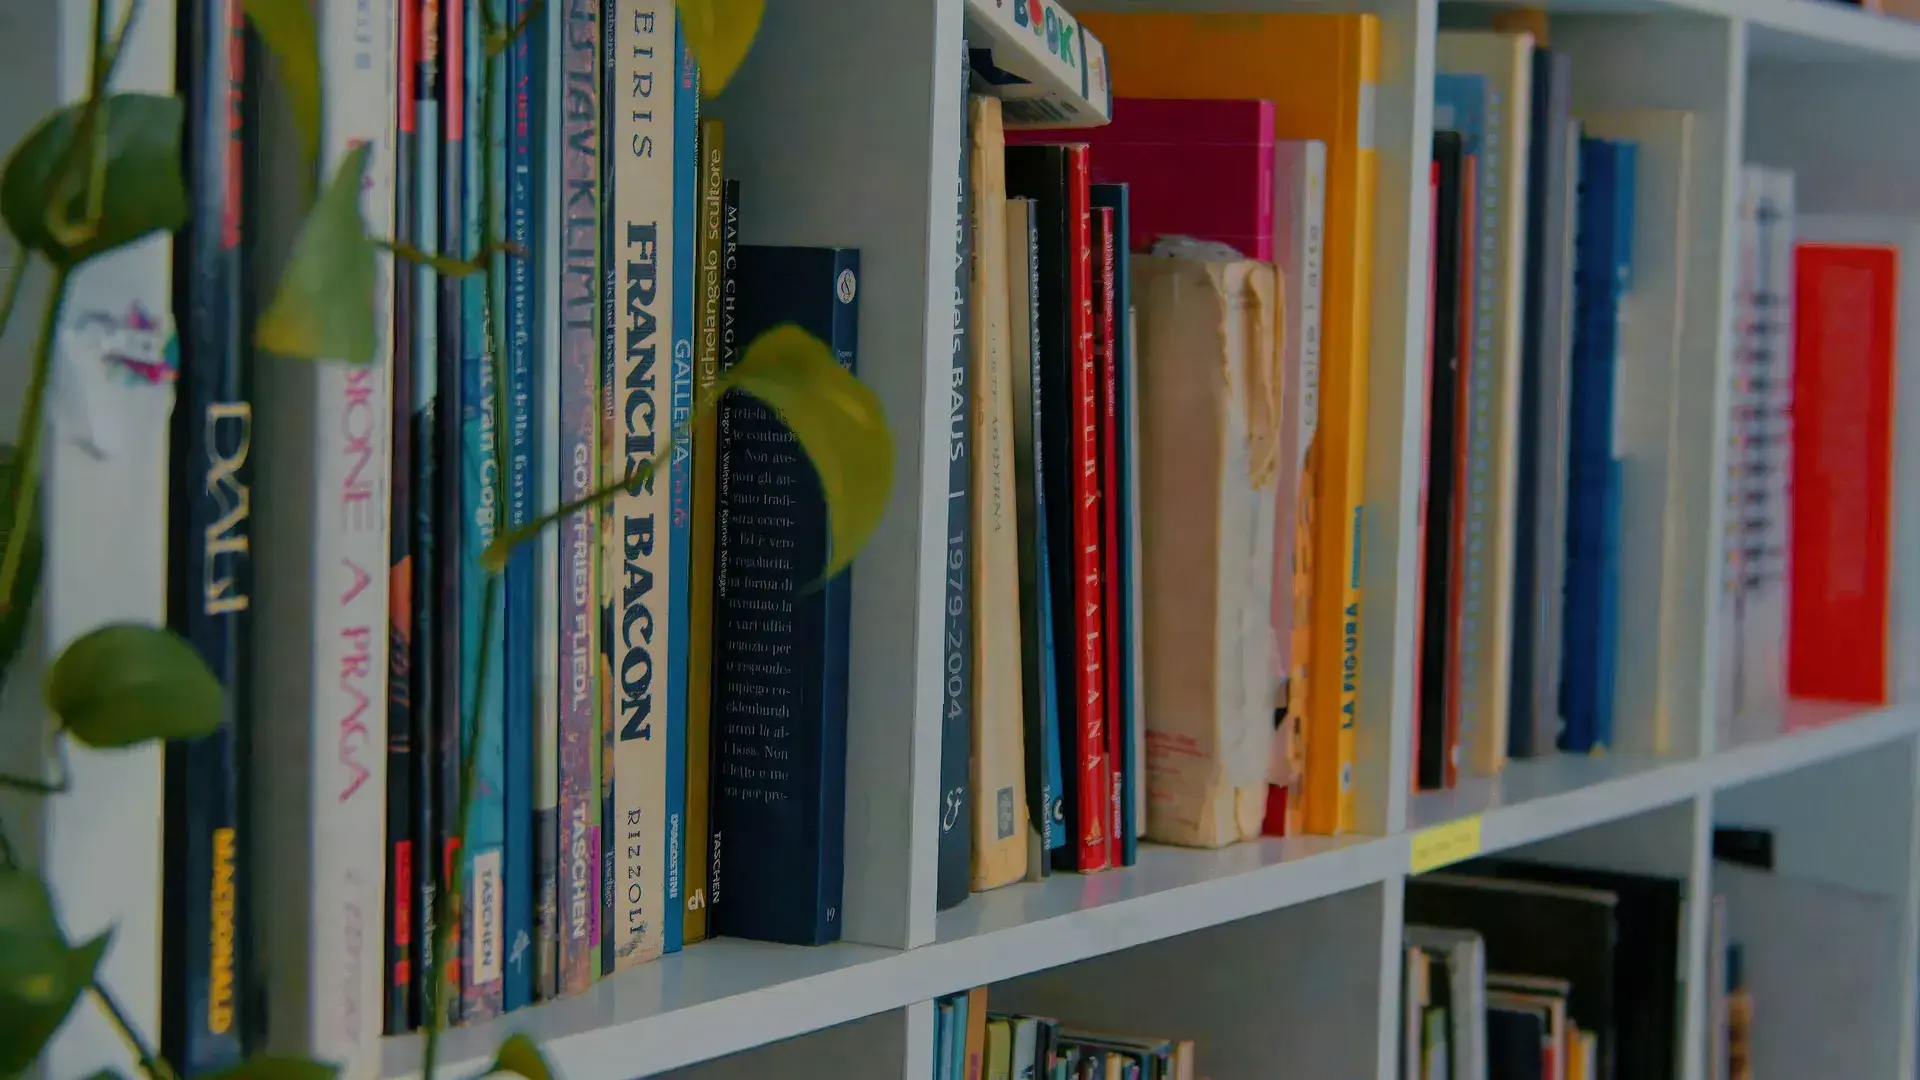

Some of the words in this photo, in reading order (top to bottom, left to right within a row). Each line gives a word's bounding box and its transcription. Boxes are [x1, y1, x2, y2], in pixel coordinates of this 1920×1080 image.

[633, 9, 657, 159] EIRIS
[704, 149, 721, 241] scultore
[726, 206, 738, 271] MARC
[566, 179, 596, 341] KLIMT
[625, 220, 658, 498] FRANCIS
[724, 279, 736, 373] CHAGAL
[953, 285, 965, 353] dels
[949, 366, 965, 462] BAUS
[339, 556, 373, 606] A
[620, 513, 656, 743] BACON
[947, 530, 964, 721] 1979-2004
[571, 614, 588, 713] FLIEDL
[1086, 545, 1101, 772] ITALIANA
[1342, 602, 1359, 694] FIGURA
[338, 627, 373, 804] PRAGA
[763, 745, 789, 760] Non
[1341, 699, 1355, 730] LA
[571, 801, 589, 941] TASCHEN
[628, 808, 648, 936] RIZZOLI
[712, 830, 722, 904] TASCHEN
[481, 868, 494, 967] TASCHEN
